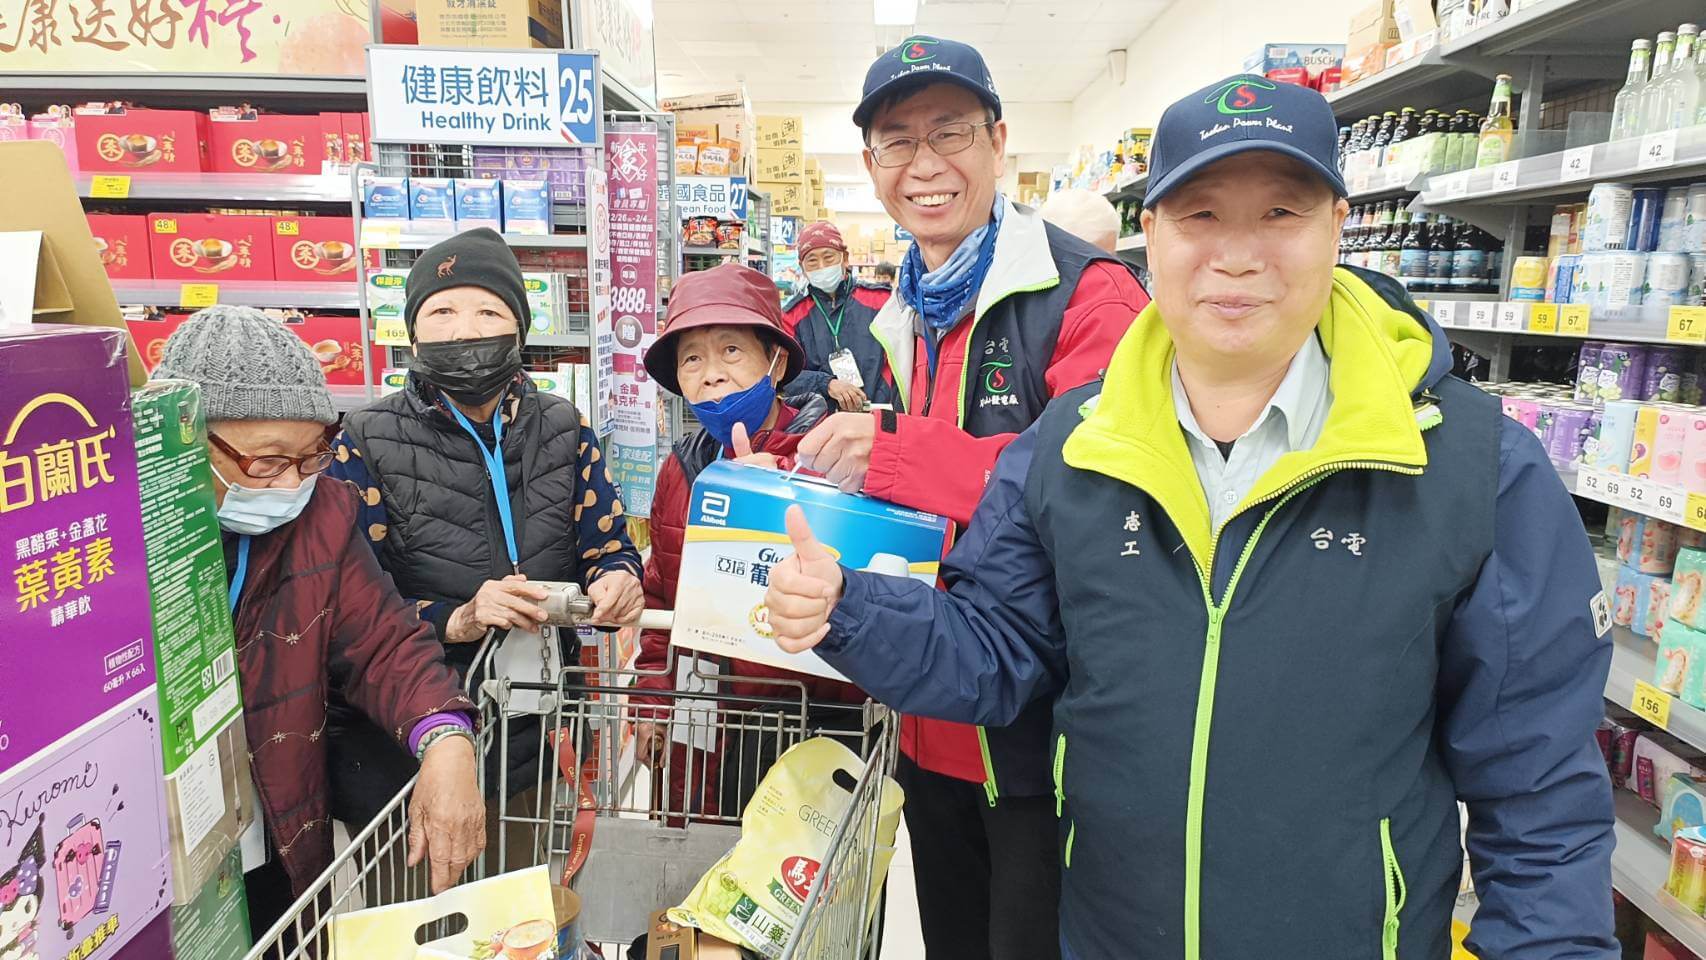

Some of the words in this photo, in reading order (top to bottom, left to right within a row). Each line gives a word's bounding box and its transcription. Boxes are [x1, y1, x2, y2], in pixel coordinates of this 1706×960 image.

[1304, 55, 1336, 66] BUSCH
[402, 64, 549, 108] 健康飲料
[560, 67, 593, 127] 25
[421, 111, 496, 134] Healthy
[503, 113, 552, 132] Drink
[1233, 117, 1263, 128] Power
[1266, 117, 1293, 134] Plant
[1648, 144, 1663, 158] 42
[1569, 158, 1581, 169] 42
[730, 182, 747, 211] 27
[703, 203, 726, 214] Food
[782, 220, 793, 239] 29
[1504, 310, 1514, 321] 59
[1537, 313, 1548, 324] 59
[1568, 314, 1579, 327] 67
[1678, 318, 1693, 332] 67
[384, 328, 406, 338] 169
[0, 426, 117, 514] 白蘭氏
[1586, 475, 1598, 489] 52
[1607, 481, 1619, 495] 69
[1630, 486, 1643, 501] 52
[1658, 495, 1673, 510] 69
[1310, 527, 1367, 556] 台電
[717, 557, 746, 576] 亞培
[13, 536, 117, 613] 葉黃素
[50, 595, 92, 628] 精華飲
[1639, 696, 1660, 715] 156
[0, 760, 100, 848] Kuromi
